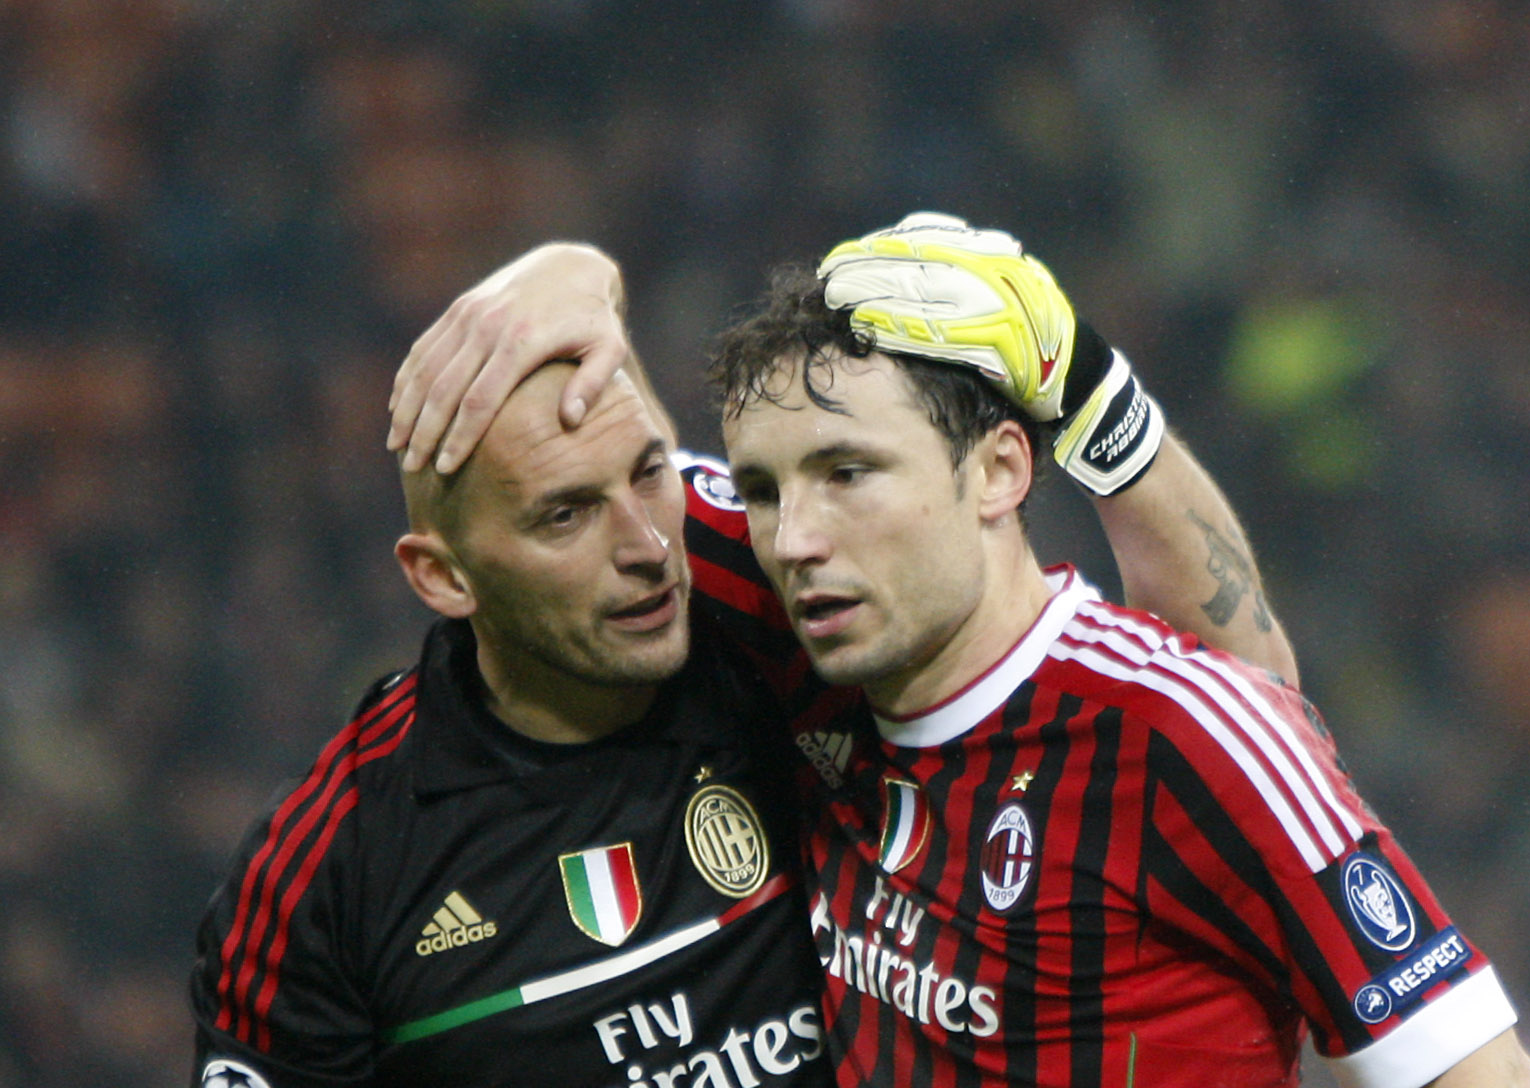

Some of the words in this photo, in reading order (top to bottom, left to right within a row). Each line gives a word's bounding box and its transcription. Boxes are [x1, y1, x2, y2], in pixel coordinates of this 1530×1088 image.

[795, 731, 843, 789] adidas
[700, 799, 734, 825] ACM
[996, 809, 1027, 833] ACM
[724, 863, 755, 883] 1899
[988, 887, 1016, 902] 1899
[415, 919, 498, 957] adidas
[1388, 935, 1464, 997] RESPECT
[593, 993, 695, 1065] Fly
